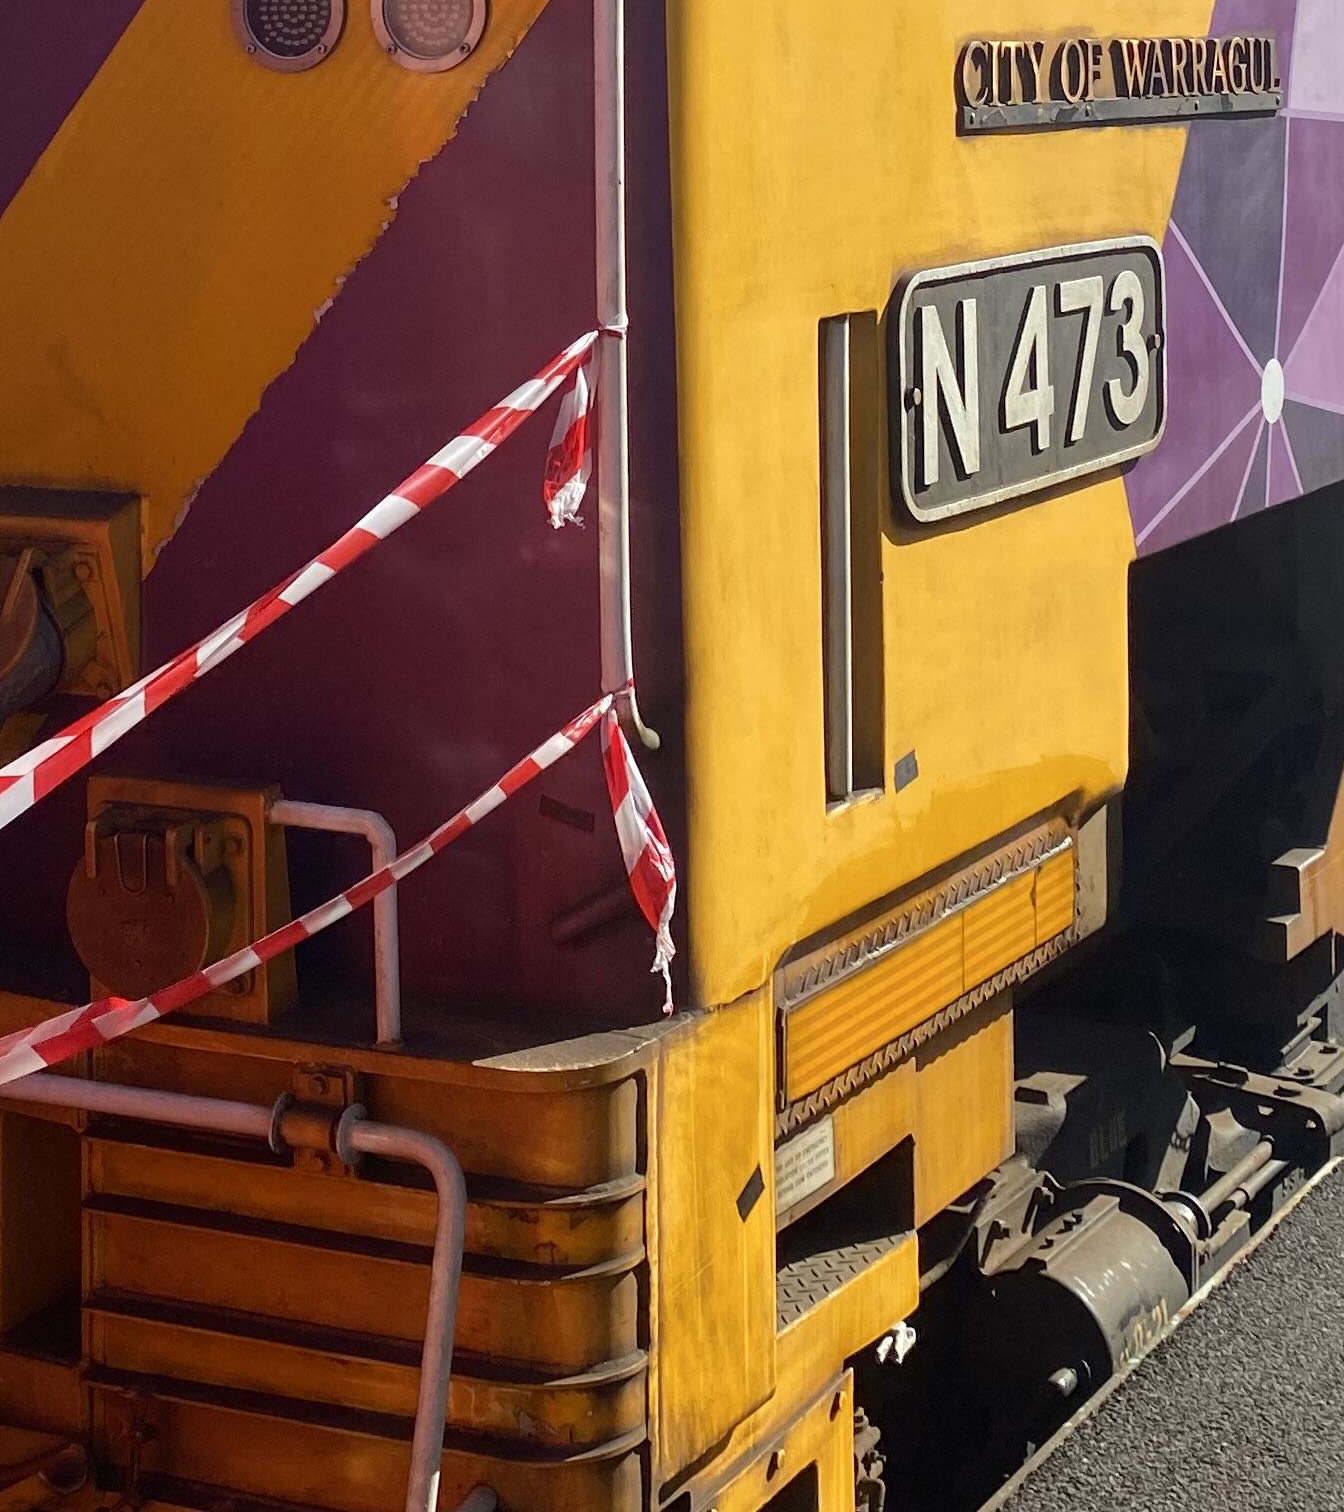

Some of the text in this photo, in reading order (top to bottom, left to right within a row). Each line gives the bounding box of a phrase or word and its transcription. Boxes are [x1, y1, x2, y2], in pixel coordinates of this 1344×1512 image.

[962, 36, 1282, 109] CITY OF WARRAGUL
[921, 270, 1150, 486] N 473
